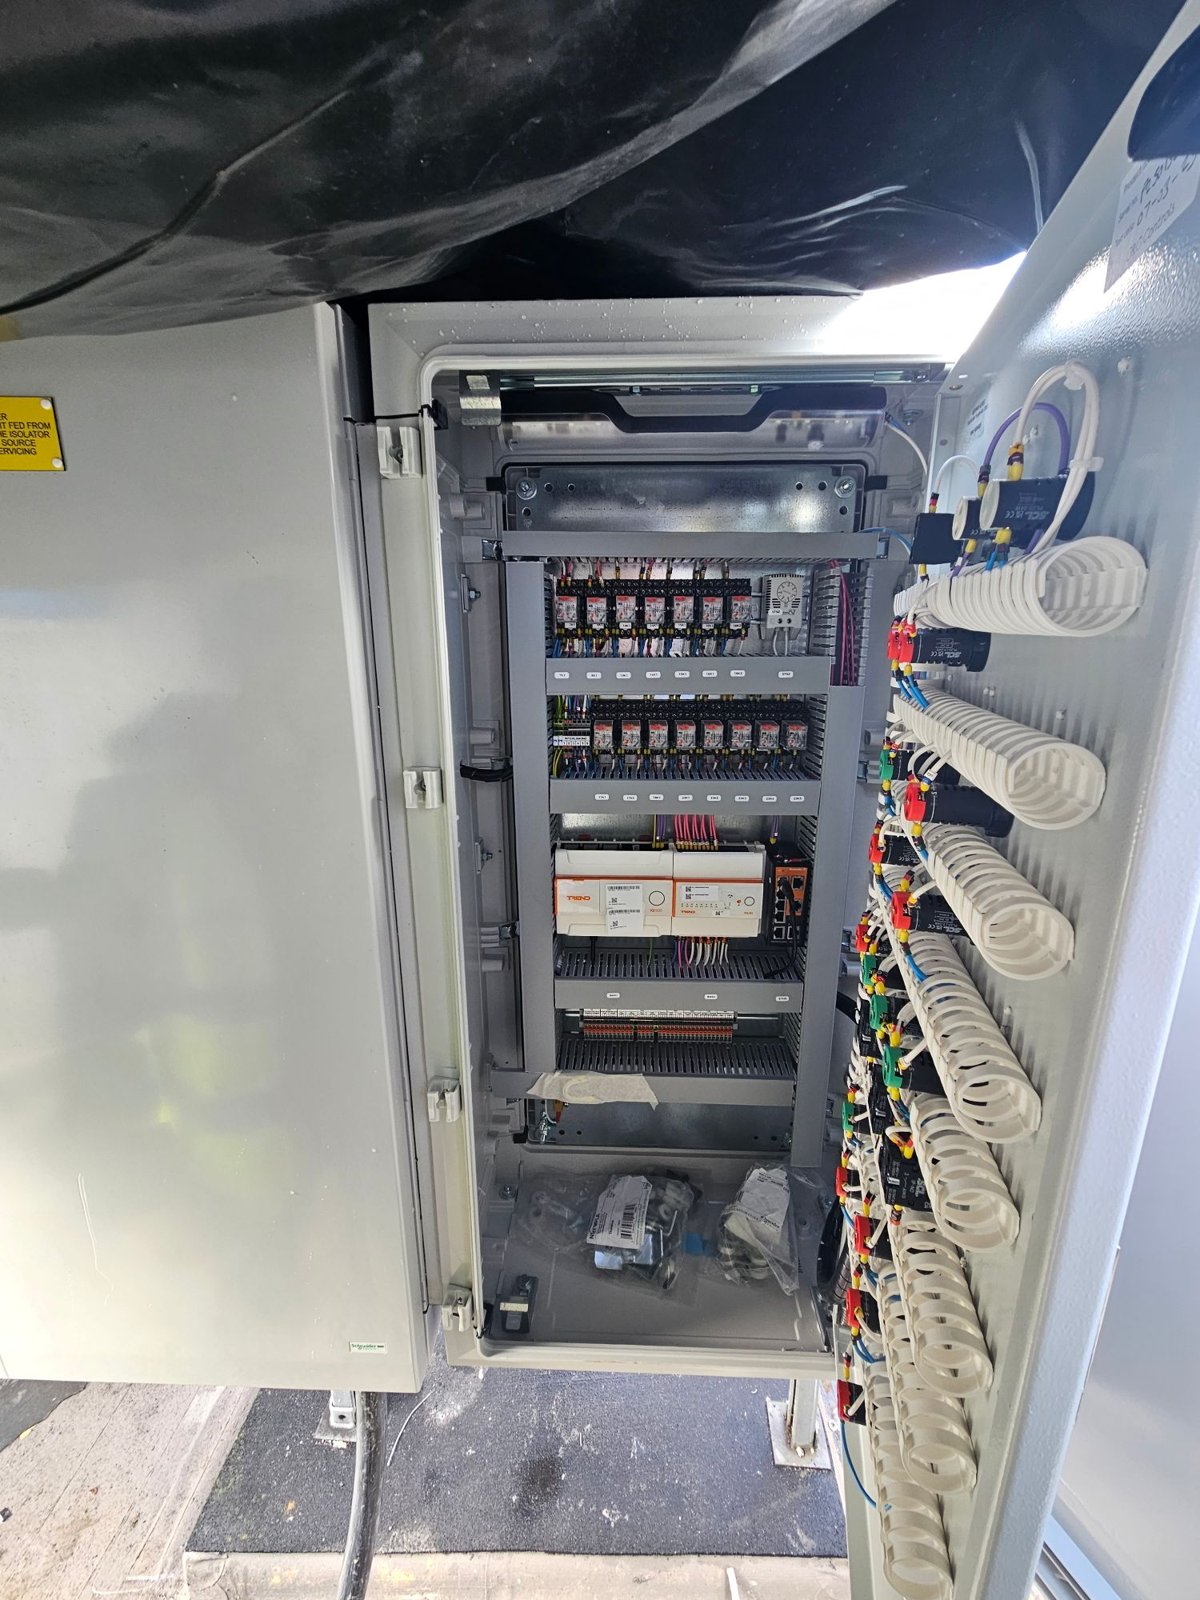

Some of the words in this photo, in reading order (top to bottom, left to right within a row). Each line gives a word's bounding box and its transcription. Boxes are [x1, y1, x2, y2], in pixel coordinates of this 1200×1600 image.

[0, 413, 8, 421] R
[0, 422, 6, 430] T
[8, 422, 25, 430] FED
[27, 422, 51, 430] FROM
[10, 431, 51, 439] ISOLATOR
[2, 439, 36, 447] SOURCE
